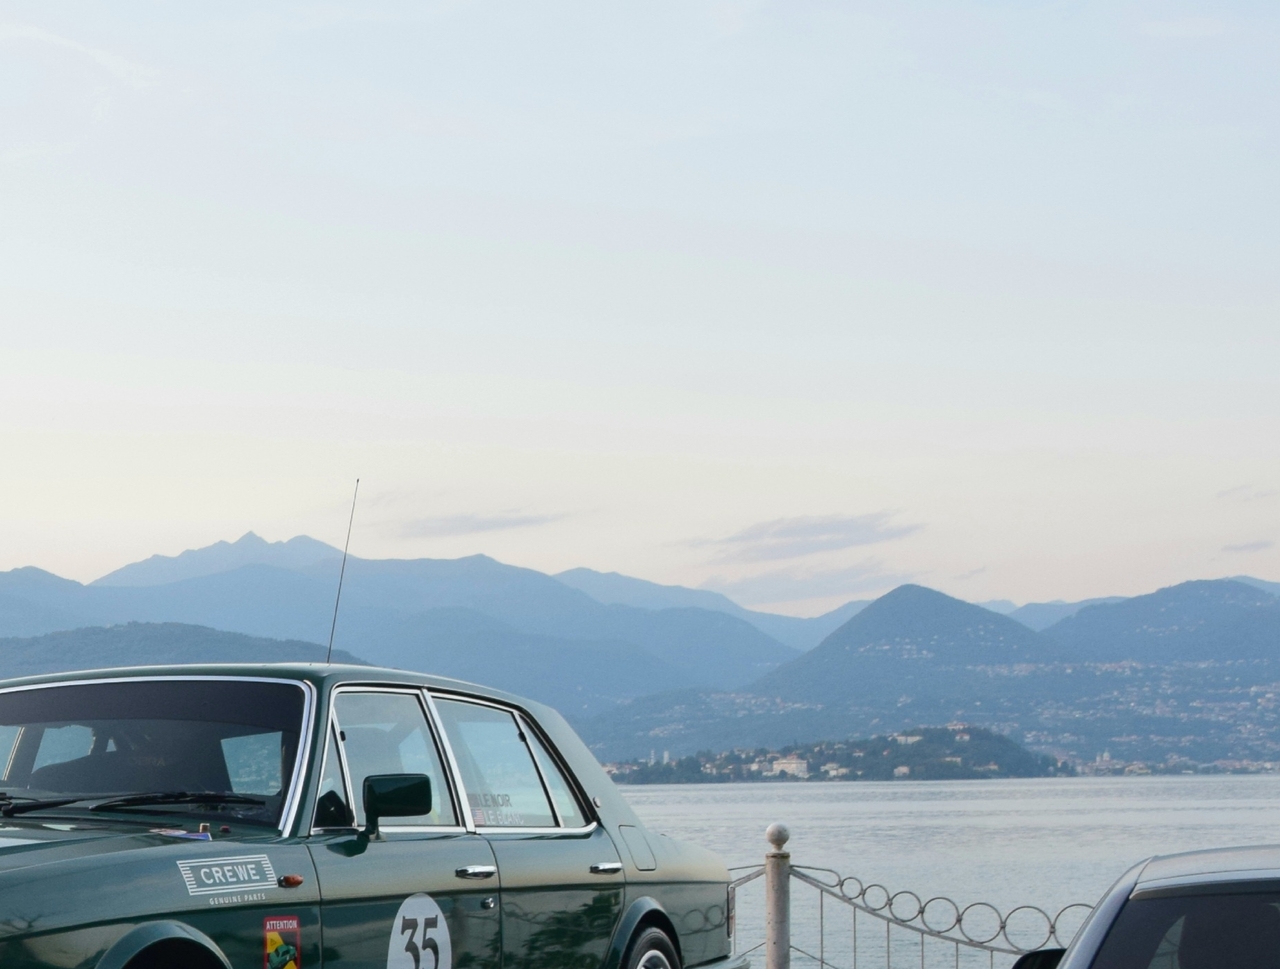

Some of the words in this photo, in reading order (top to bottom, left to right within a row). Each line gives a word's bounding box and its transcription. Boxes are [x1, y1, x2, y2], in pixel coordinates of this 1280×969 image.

[200, 864, 260, 884] CREWE
[209, 895, 242, 905] GENUINE
[244, 893, 266, 902] PARTS
[266, 920, 298, 930] ATTENTION
